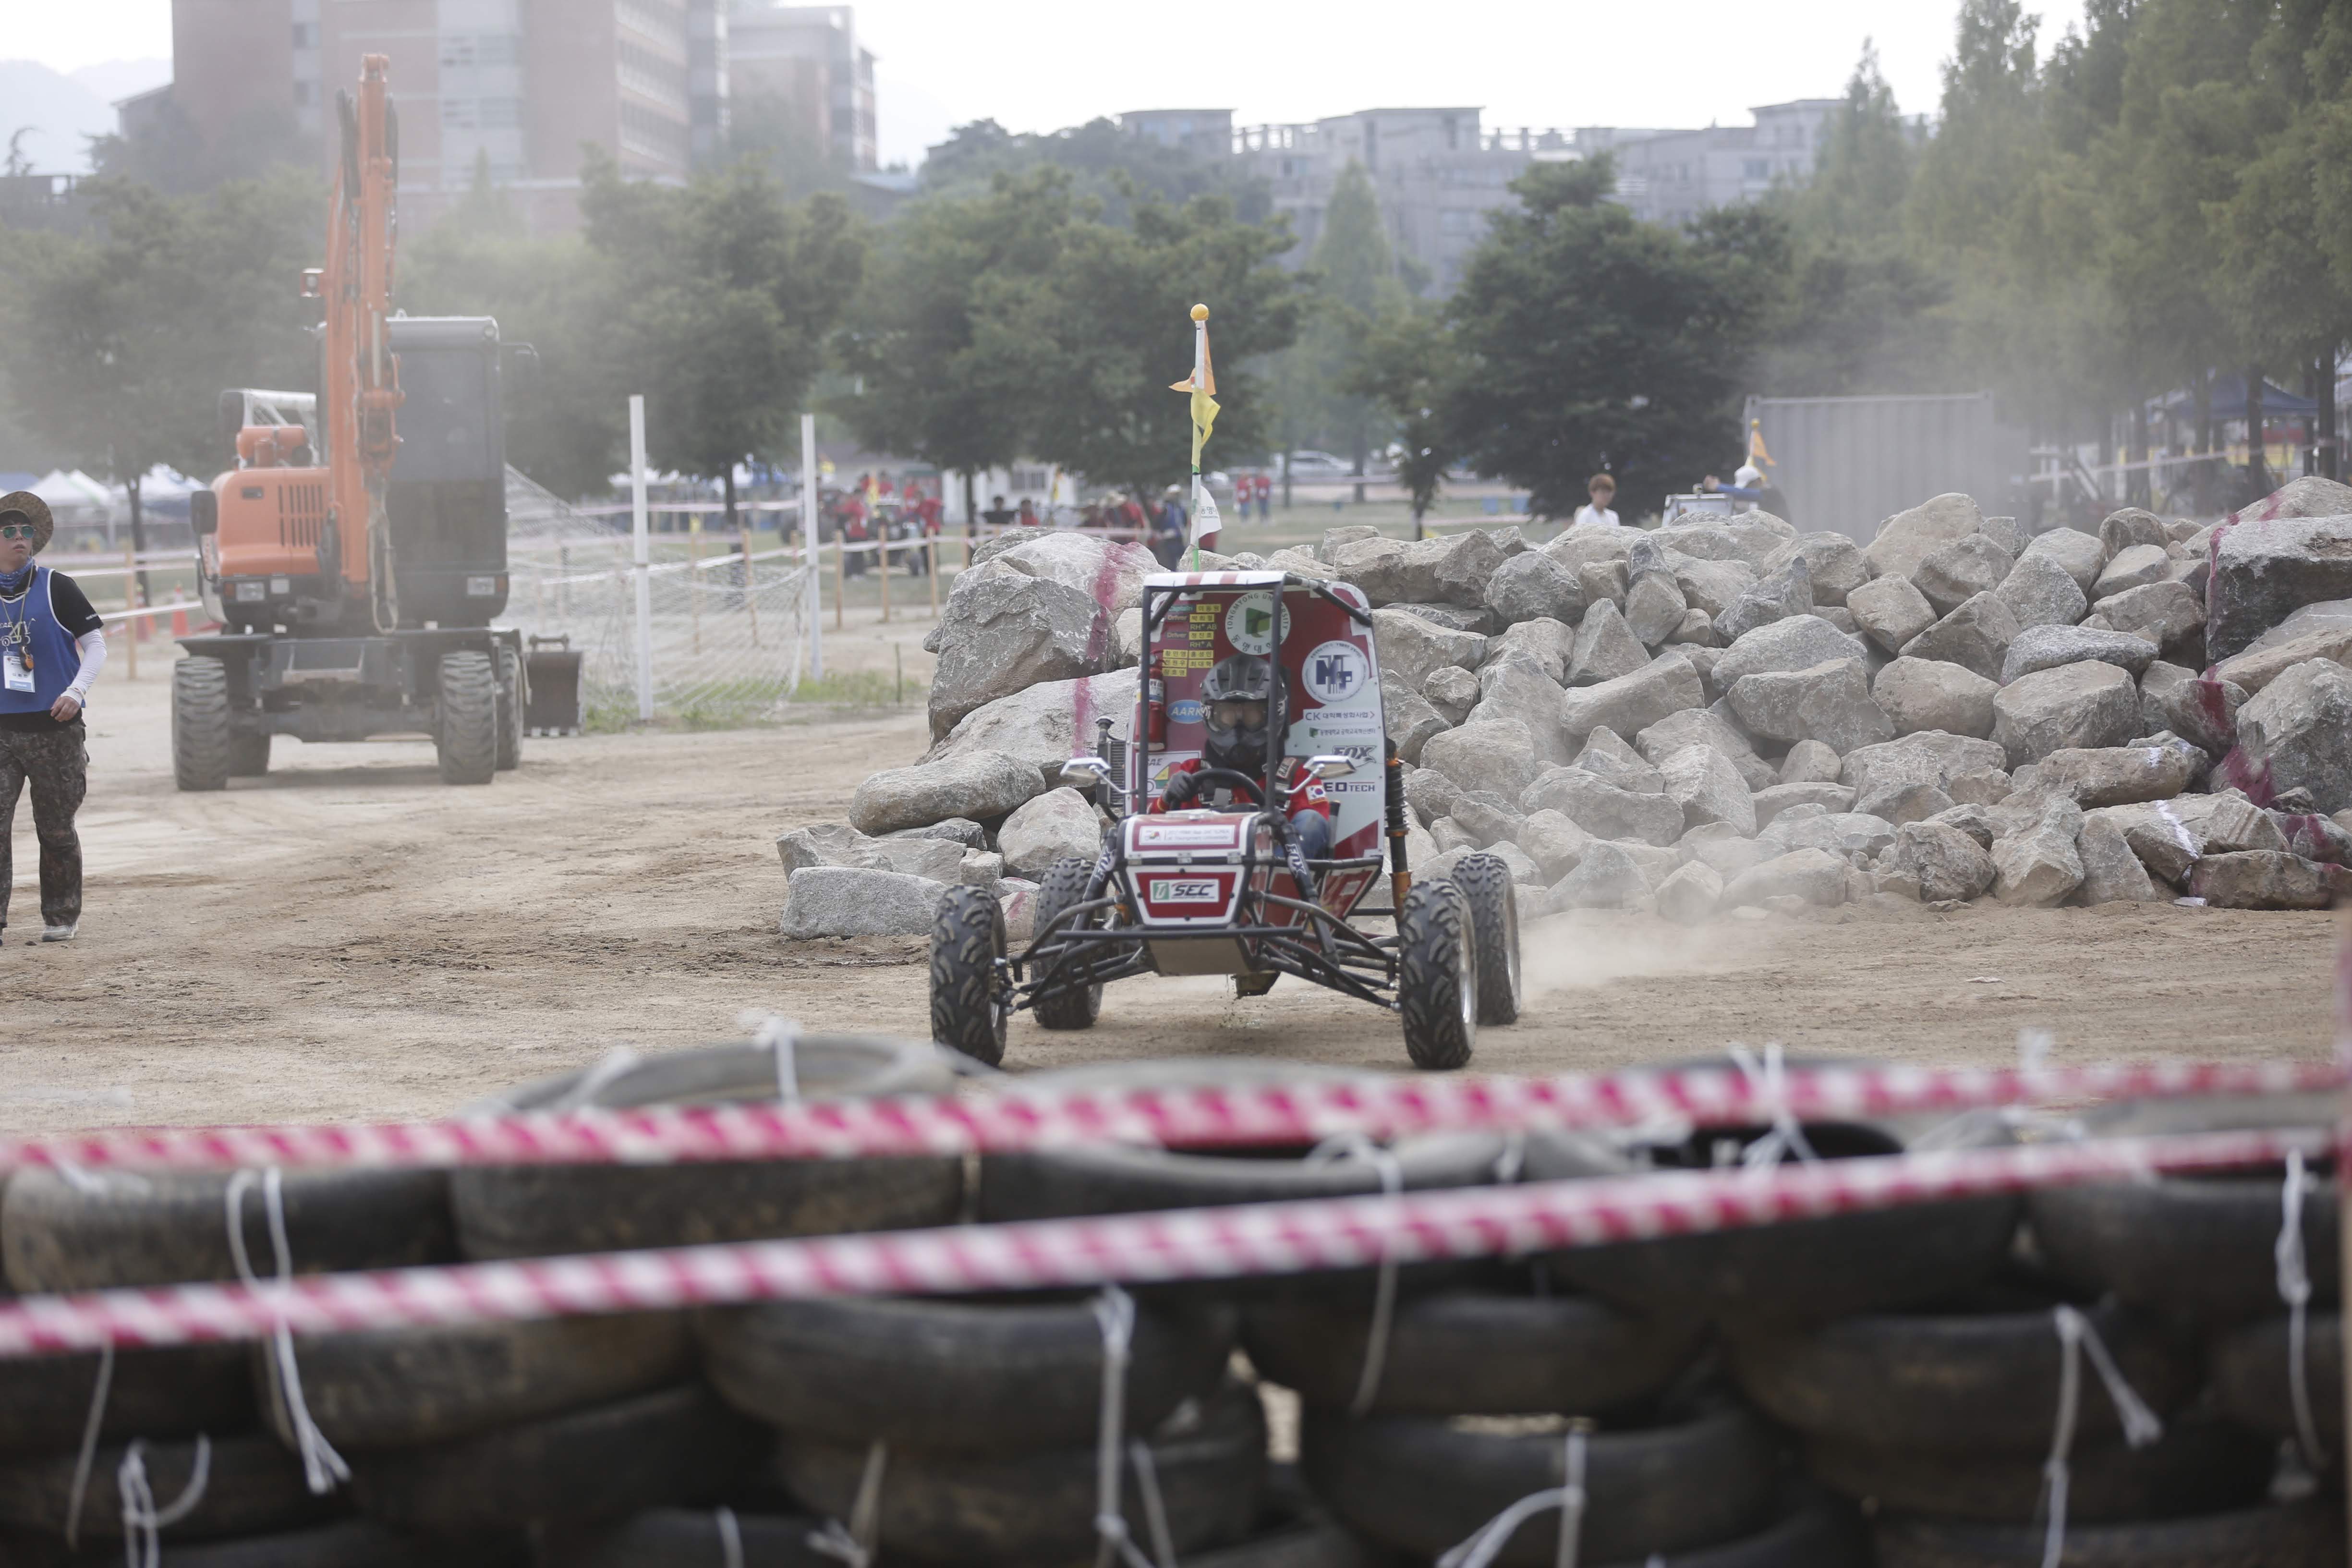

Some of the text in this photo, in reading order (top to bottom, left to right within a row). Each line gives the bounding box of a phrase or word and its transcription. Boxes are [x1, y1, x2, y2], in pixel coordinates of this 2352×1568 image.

[1227, 593, 1259, 630] TONGMYONG
[1231, 634, 1284, 654] 동명대학
[1333, 746, 1375, 760] FOX
[1323, 782, 1347, 791] EO
[1172, 884, 1214, 896] SEC
